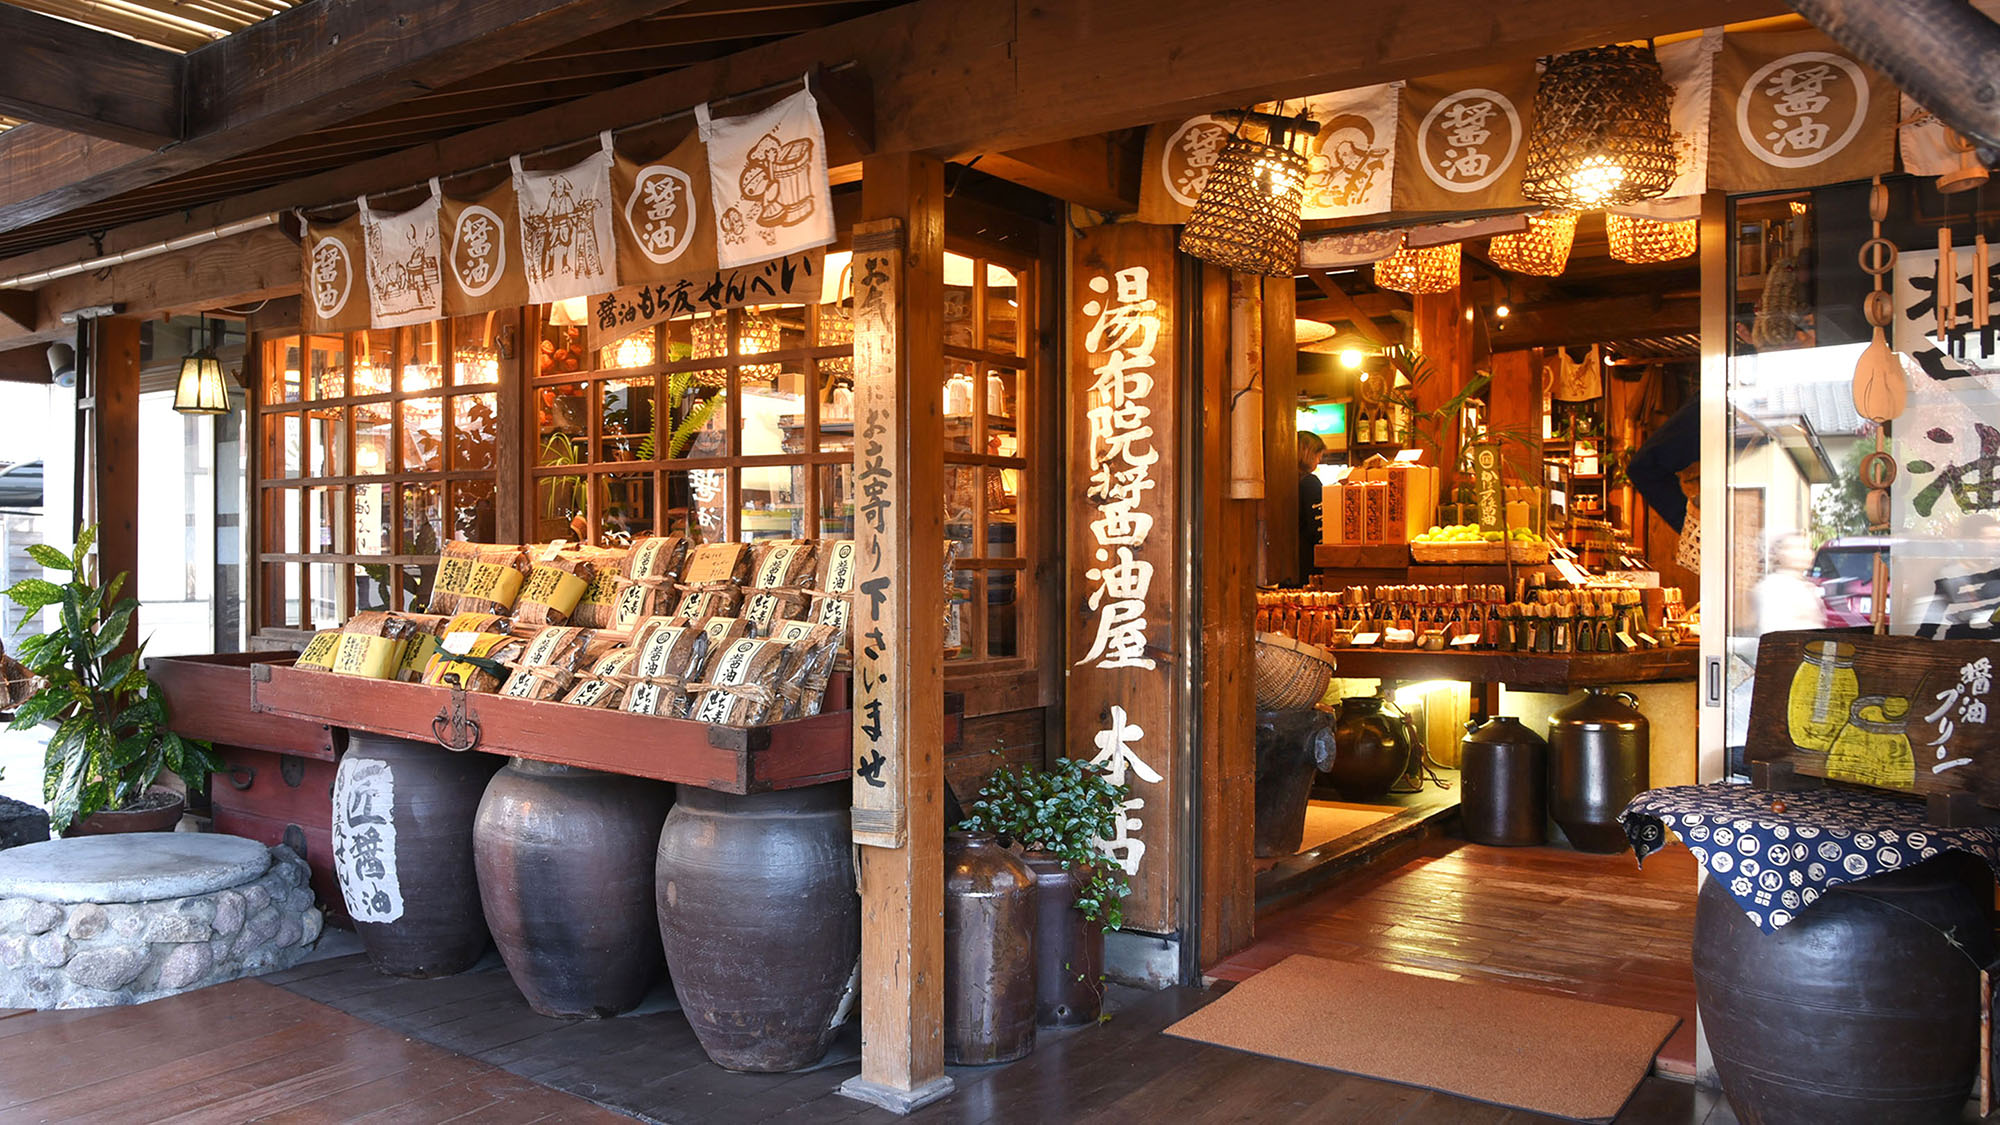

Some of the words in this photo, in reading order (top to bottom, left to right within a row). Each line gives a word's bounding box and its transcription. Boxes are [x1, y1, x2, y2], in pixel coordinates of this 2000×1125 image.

[1440, 101, 1497, 180] 醤油
[1764, 64, 1838, 154] 醤油
[462, 216, 493, 286] 醤油
[641, 176, 682, 252] 醤油
[314, 246, 342, 308] 醤油
[1074, 266, 1160, 671] 湯布院醤油屋
[1924, 682, 1973, 774] プリン
[1958, 657, 1992, 723] 醤油
